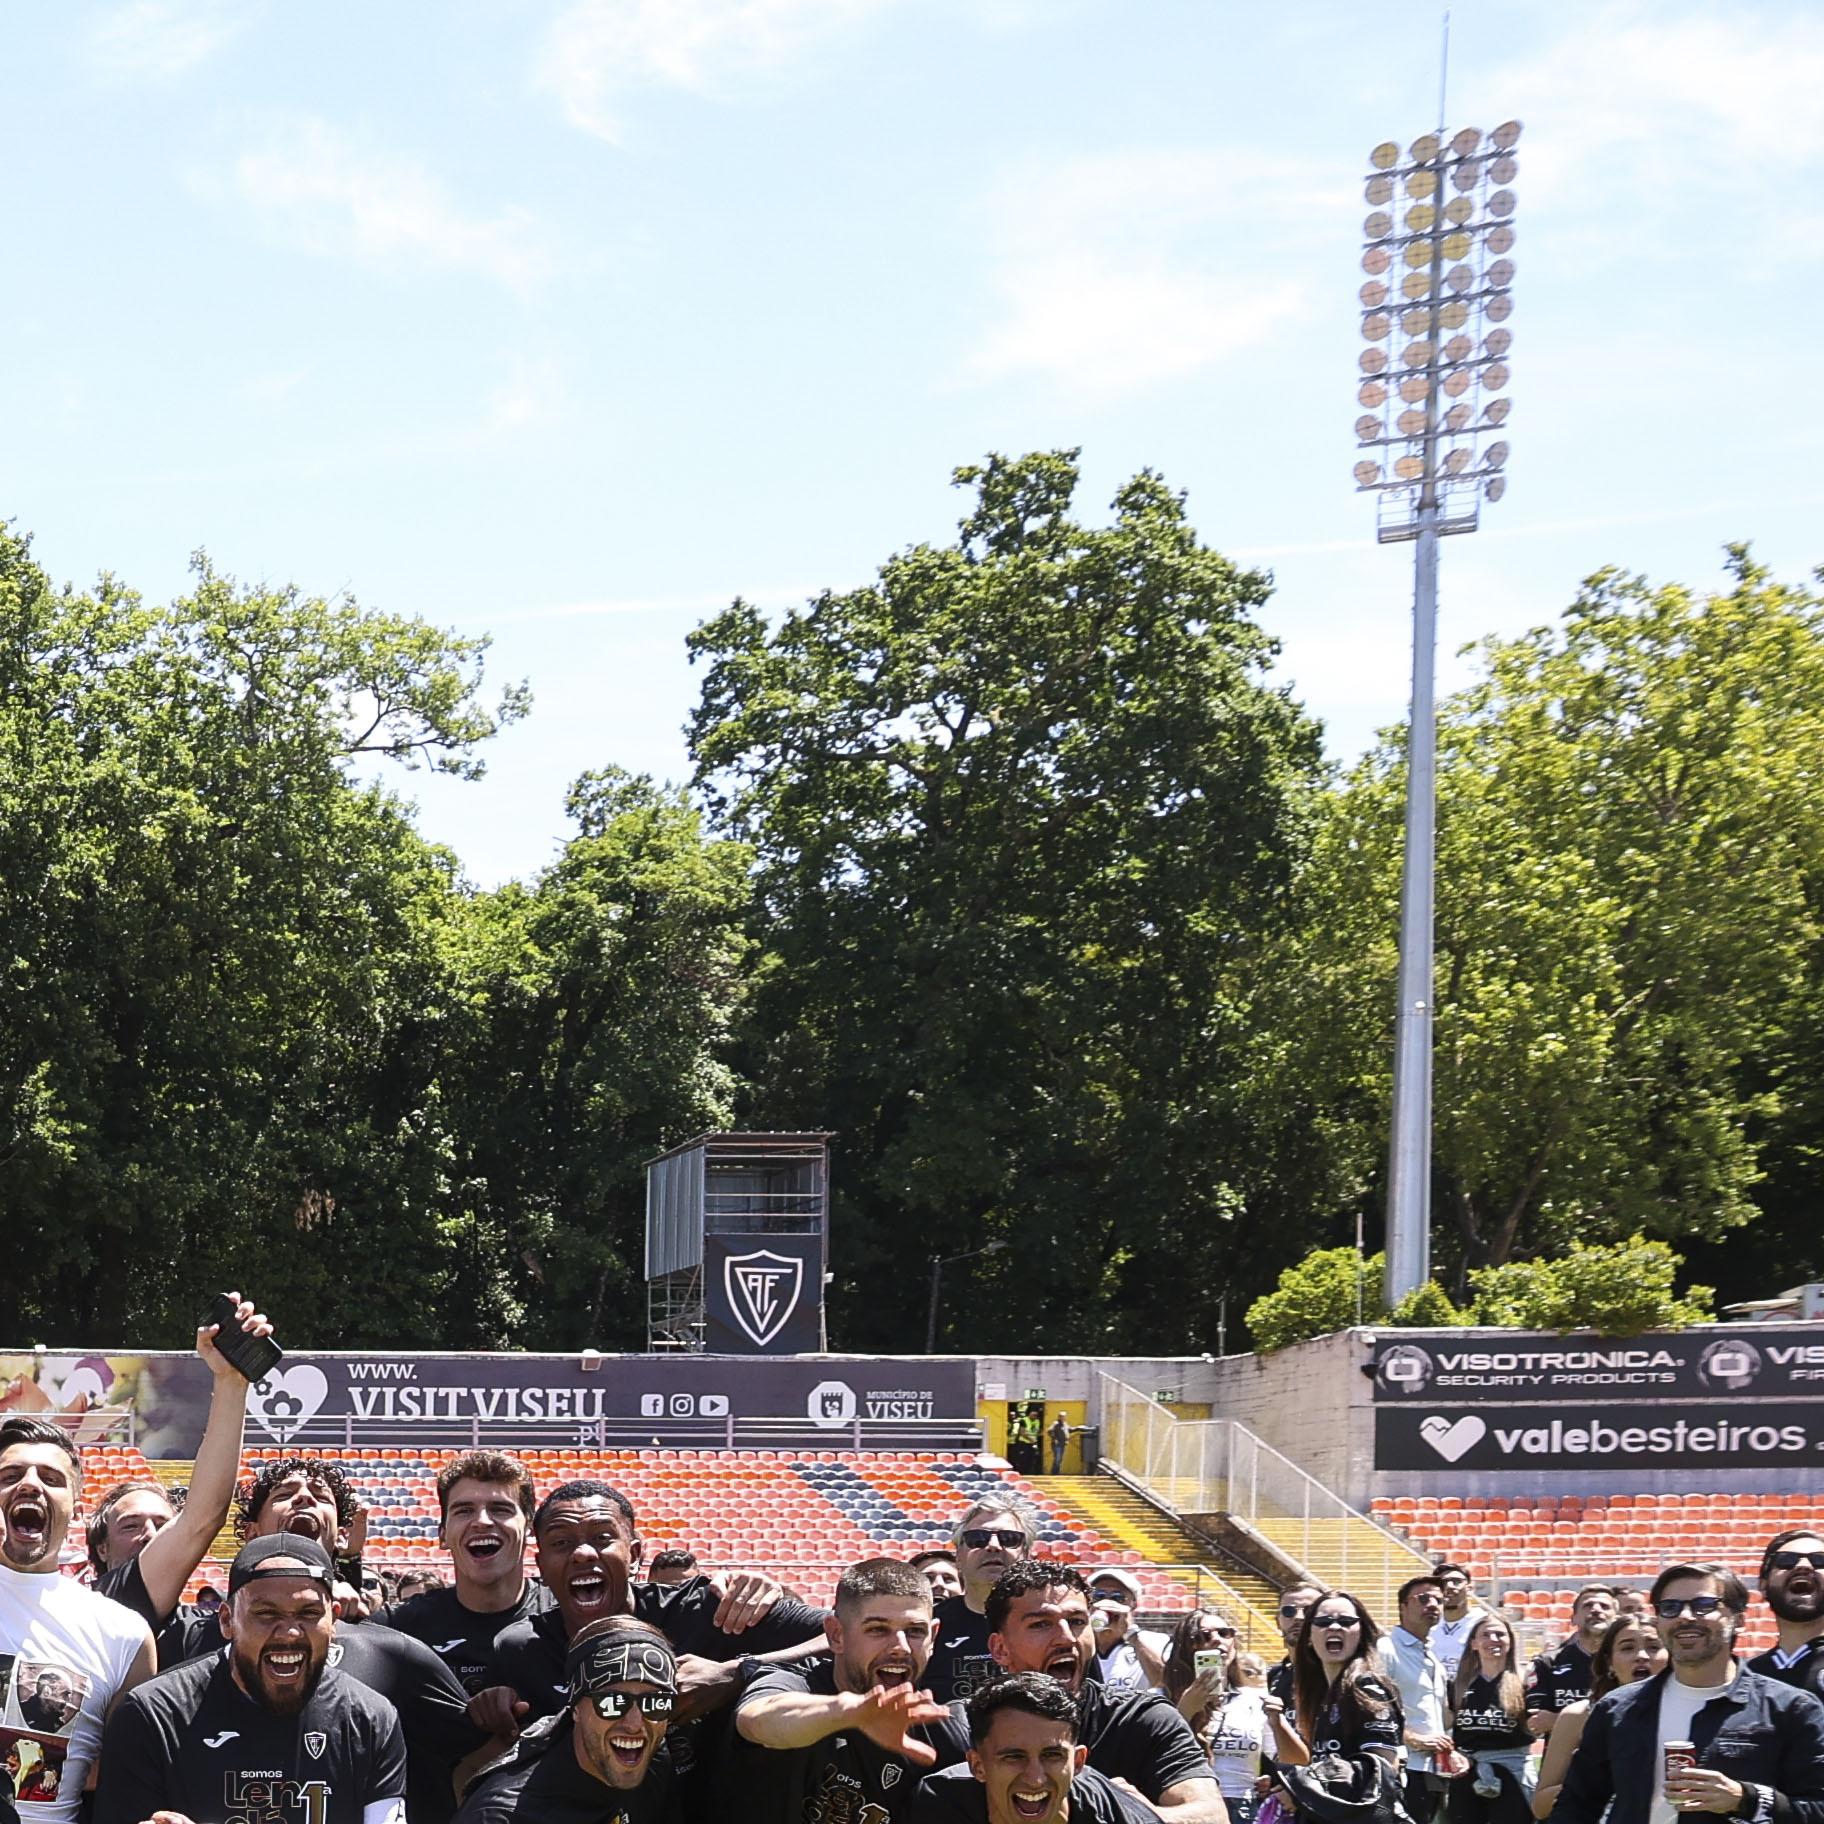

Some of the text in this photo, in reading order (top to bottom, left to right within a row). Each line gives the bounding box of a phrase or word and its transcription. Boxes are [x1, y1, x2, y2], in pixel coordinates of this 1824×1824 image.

[347, 1363, 418, 1380] www.
[1436, 1372, 1677, 1387] SECURITY PRODUCTS
[920, 1391, 934, 1400] DE
[865, 1401, 934, 1419] VISEU
[1493, 1418, 1807, 1454] valebesteiros
[642, 1697, 673, 1713] LIGA
[240, 1770, 283, 1779] somos
